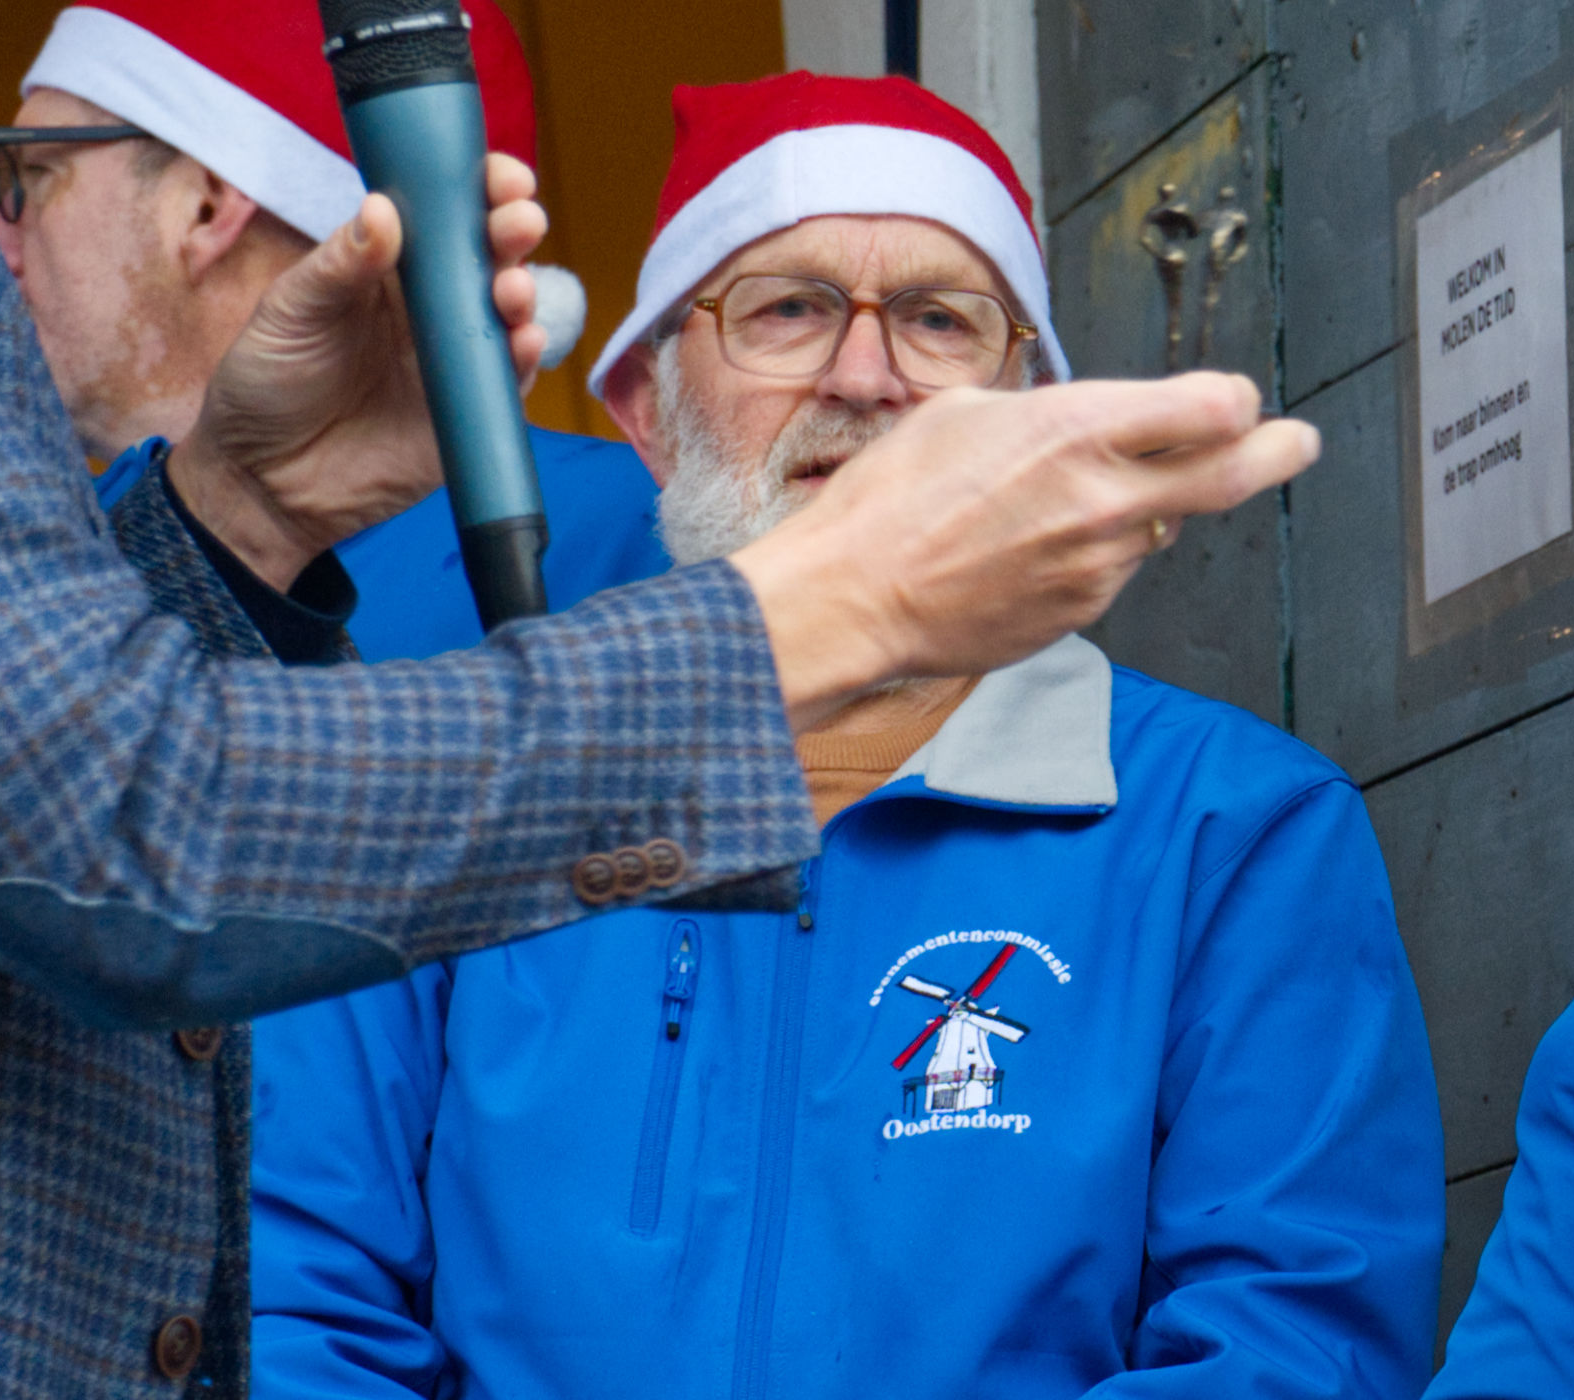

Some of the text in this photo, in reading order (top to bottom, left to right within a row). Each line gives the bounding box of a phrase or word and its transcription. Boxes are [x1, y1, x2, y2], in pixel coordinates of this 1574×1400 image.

[1447, 243, 1506, 304] WELKOM IN
[1441, 310, 1476, 355] MOLEN
[1477, 299, 1492, 333] DE
[1432, 379, 1530, 455] Kom naar binnen en
[1444, 430, 1522, 495] de trap omhoog
[882, 1108, 1032, 1140] Oostendorp
